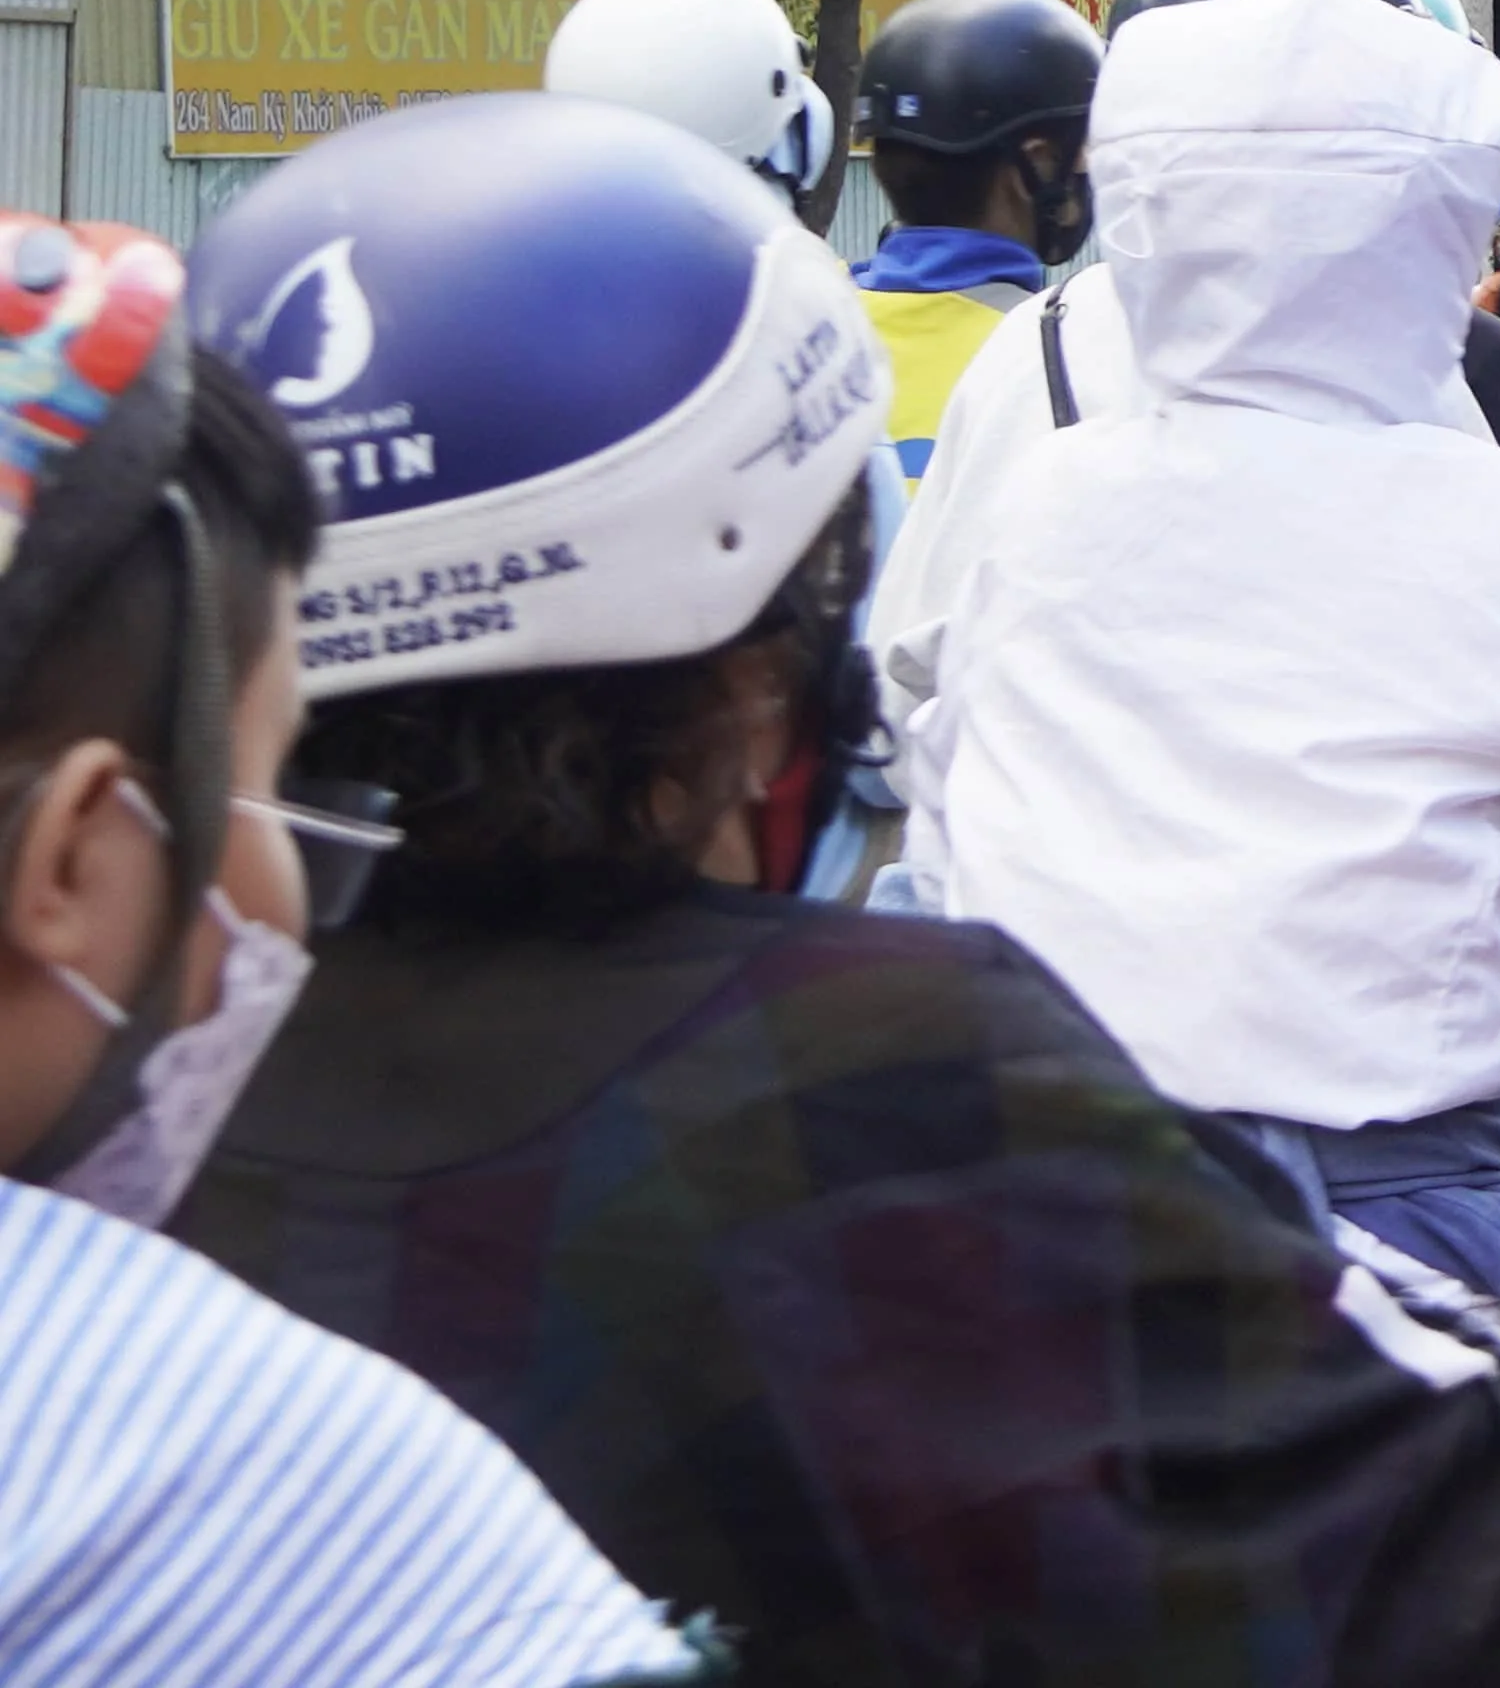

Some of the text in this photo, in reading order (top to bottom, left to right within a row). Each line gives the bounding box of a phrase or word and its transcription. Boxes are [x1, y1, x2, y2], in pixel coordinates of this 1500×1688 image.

[175, 89, 209, 133] 264
[217, 93, 257, 134] Nam
[306, 432, 436, 496] TIN
